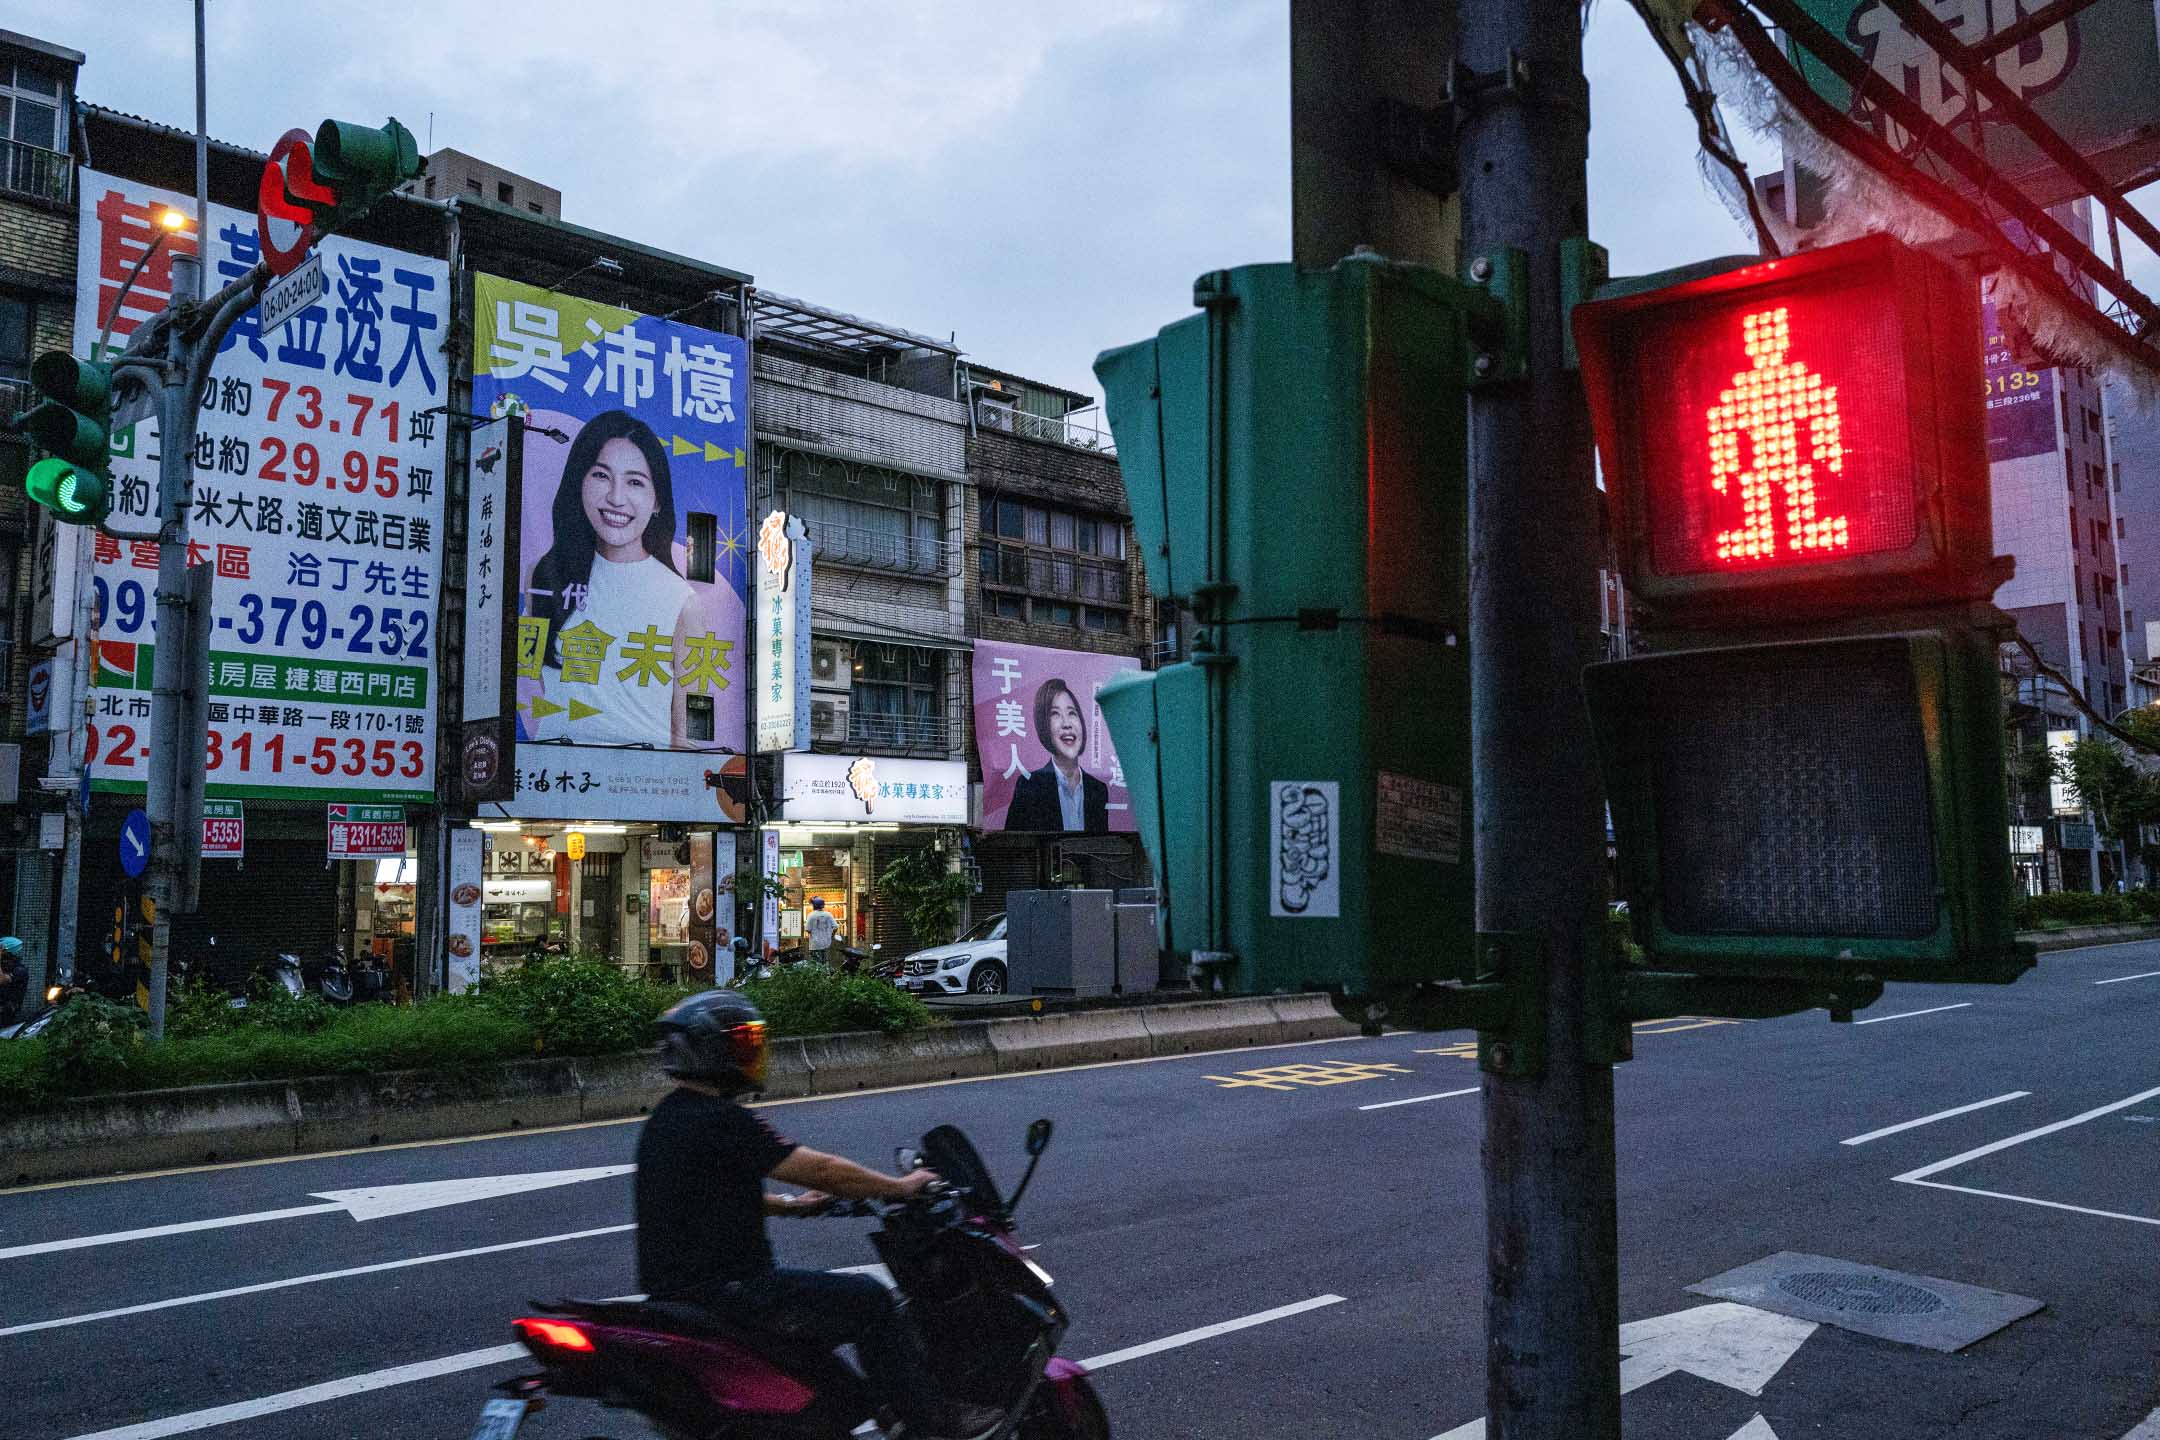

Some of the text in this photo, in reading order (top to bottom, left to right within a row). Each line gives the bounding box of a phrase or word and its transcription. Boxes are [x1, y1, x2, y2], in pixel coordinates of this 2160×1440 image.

[264, 267, 318, 321] 06:00-24:00
[490, 300, 735, 424] 吳沛憶
[262, 378, 400, 443] 73.71
[408, 411, 436, 448] 坪
[258, 437, 399, 498] 29.95
[407, 466, 435, 501] 坪
[287, 551, 431, 600] 洽丁先生
[517, 618, 734, 692] 國會未來
[771, 594, 783, 704] 冰菓專業家
[285, 667, 416, 699] 捷運西門店
[992, 657, 1032, 781] 于美人
[878, 782, 944, 800] 冰菓專業家
[331, 823, 404, 852] 售 2311-5353
